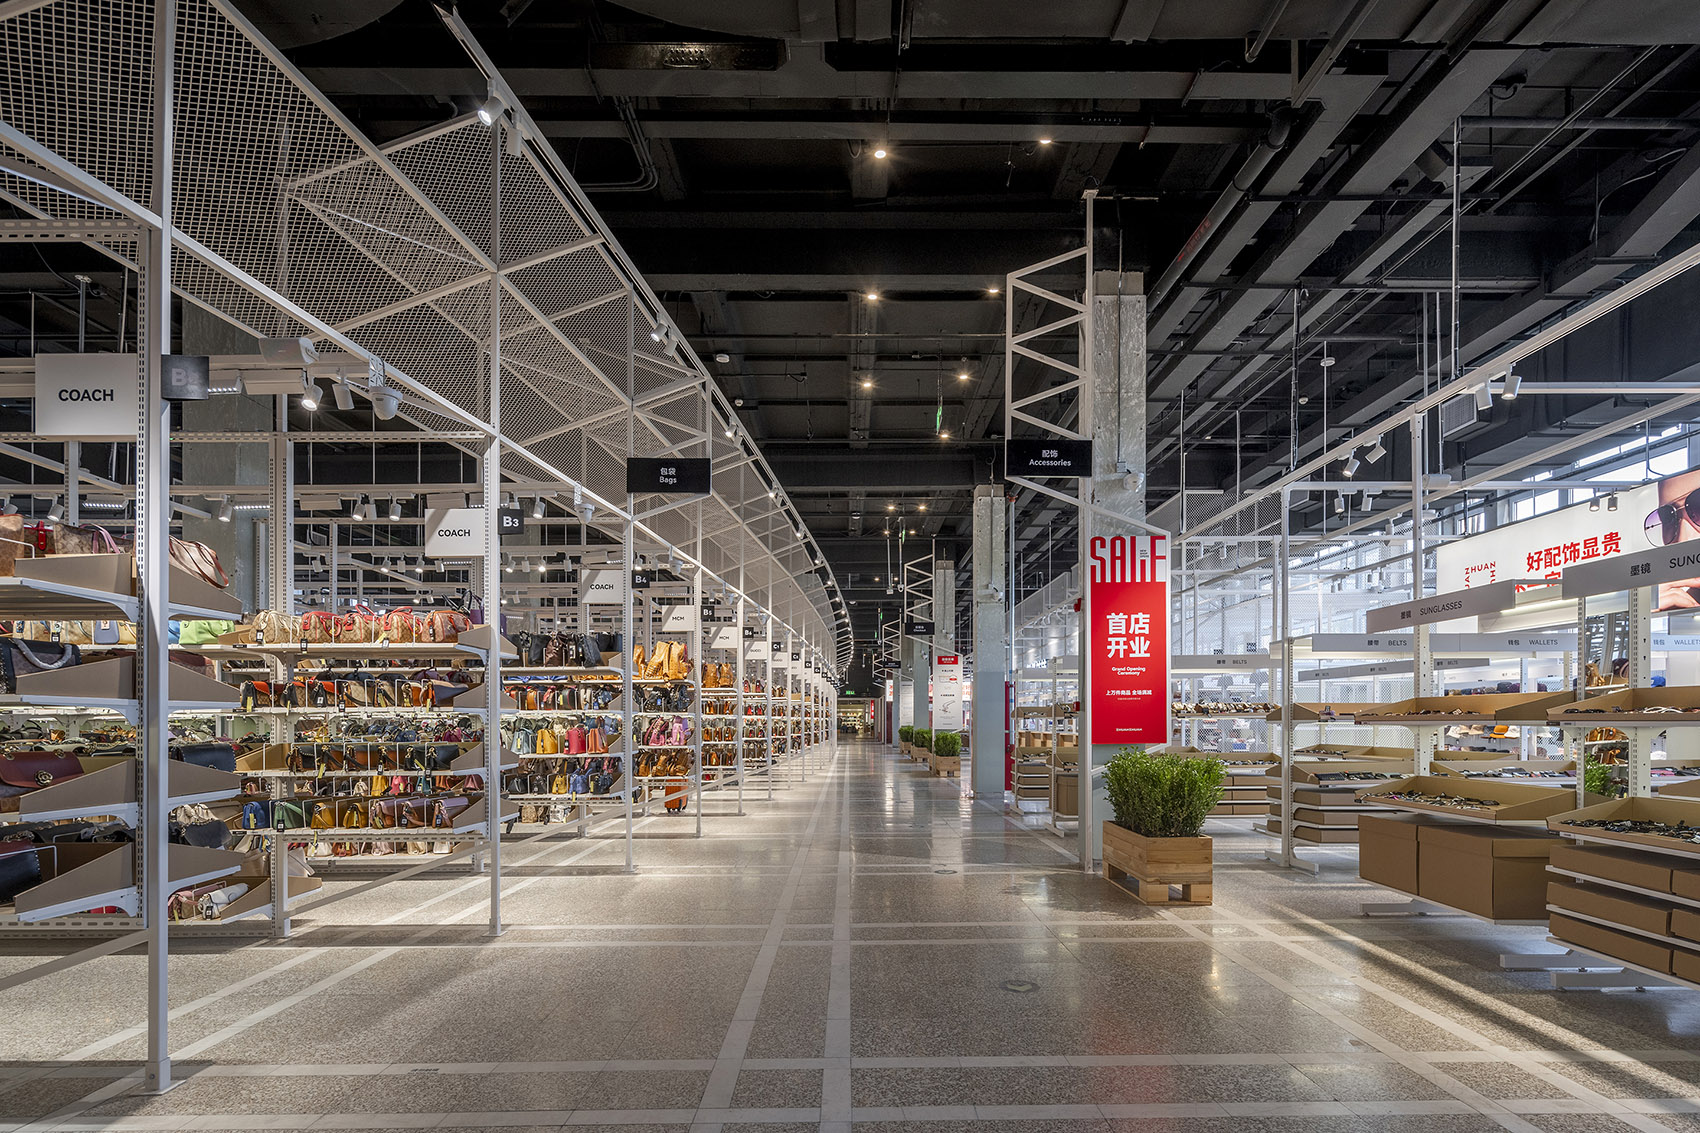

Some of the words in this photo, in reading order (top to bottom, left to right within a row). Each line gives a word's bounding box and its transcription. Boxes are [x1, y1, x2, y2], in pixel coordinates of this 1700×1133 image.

[58, 388, 114, 402] COACH
[1041, 449, 1058, 458] 配饰
[660, 467, 676, 476] 包袋
[659, 476, 677, 485] Bags
[503, 516, 519, 527] B3
[437, 529, 471, 537] COACH
[1526, 531, 1622, 573] 好配饰显贵
[1464, 561, 1496, 575] ZHUAN
[1630, 562, 1651, 577] 墨镜
[635, 575, 647, 583] B4
[1419, 600, 1463, 616] SUNGLASSES
[1106, 612, 1150, 635] 首店
[1107, 636, 1150, 658] 开业
